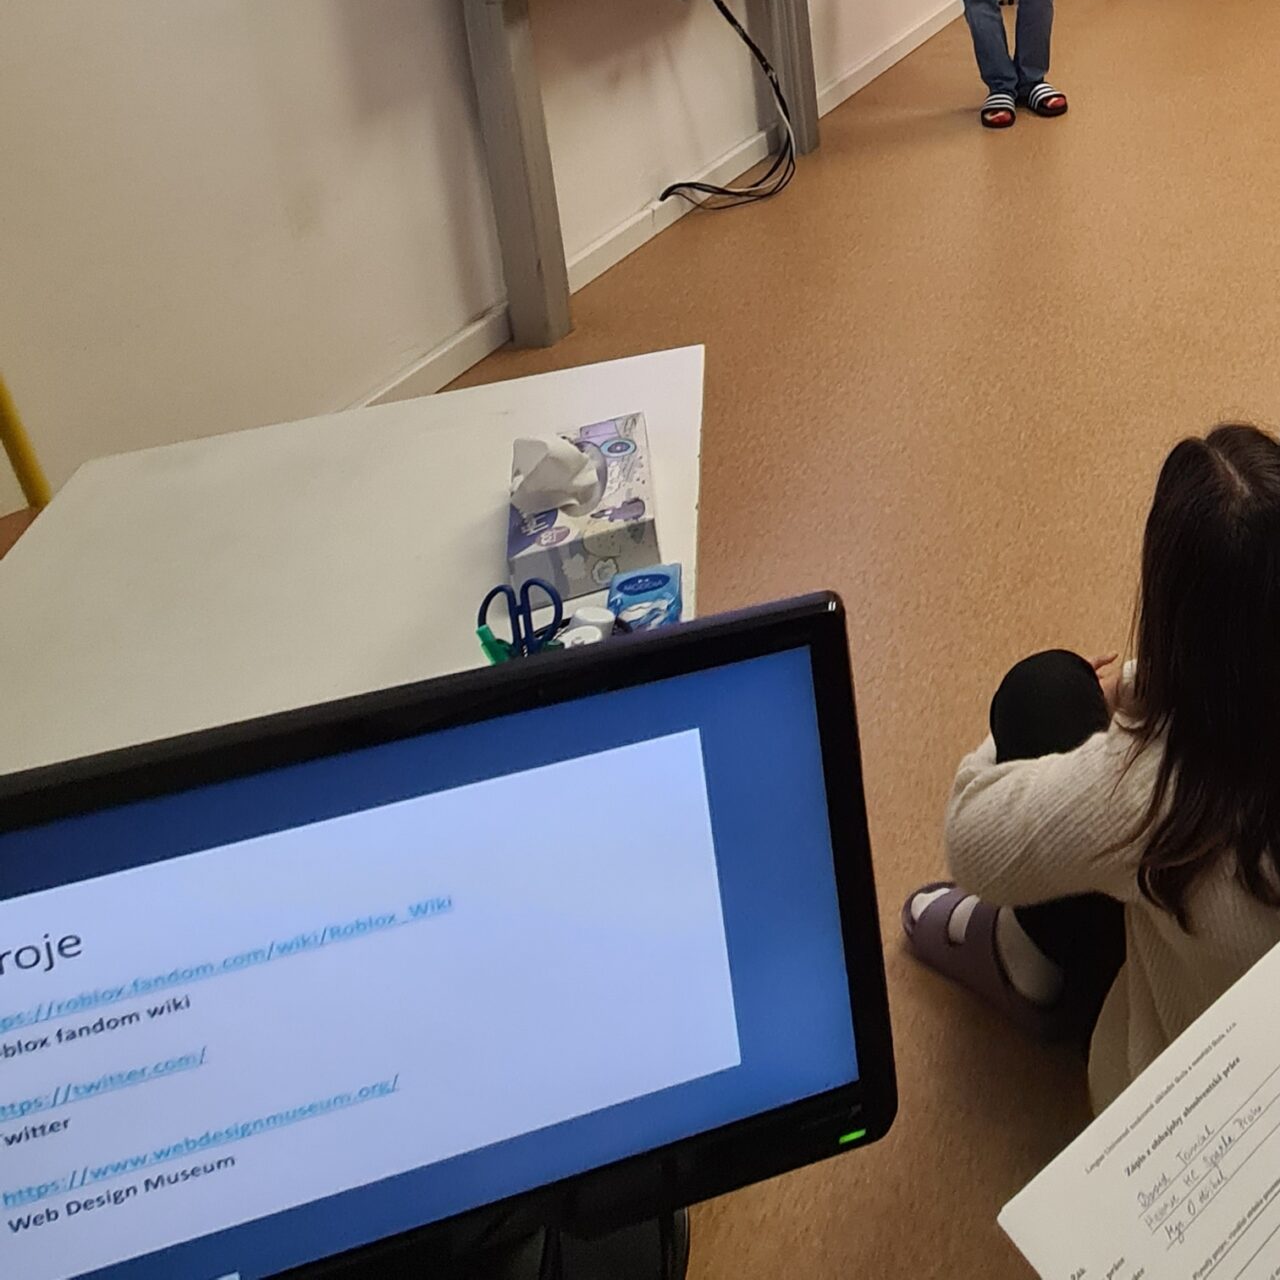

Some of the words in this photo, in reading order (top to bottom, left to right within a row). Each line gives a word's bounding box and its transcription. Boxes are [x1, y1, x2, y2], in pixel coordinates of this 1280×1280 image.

[0, 933, 82, 975] roje
[0, 1035, 51, 1058] blox
[56, 1010, 141, 1044] fandom
[147, 994, 191, 1020] wiki
[0, 1118, 71, 1147] witter
[2, 1072, 399, 1210] https://www.webdesignmuseum.org/
[8, 1207, 59, 1234] Web
[66, 1183, 138, 1217] Design
[143, 1155, 236, 1194] Museum
